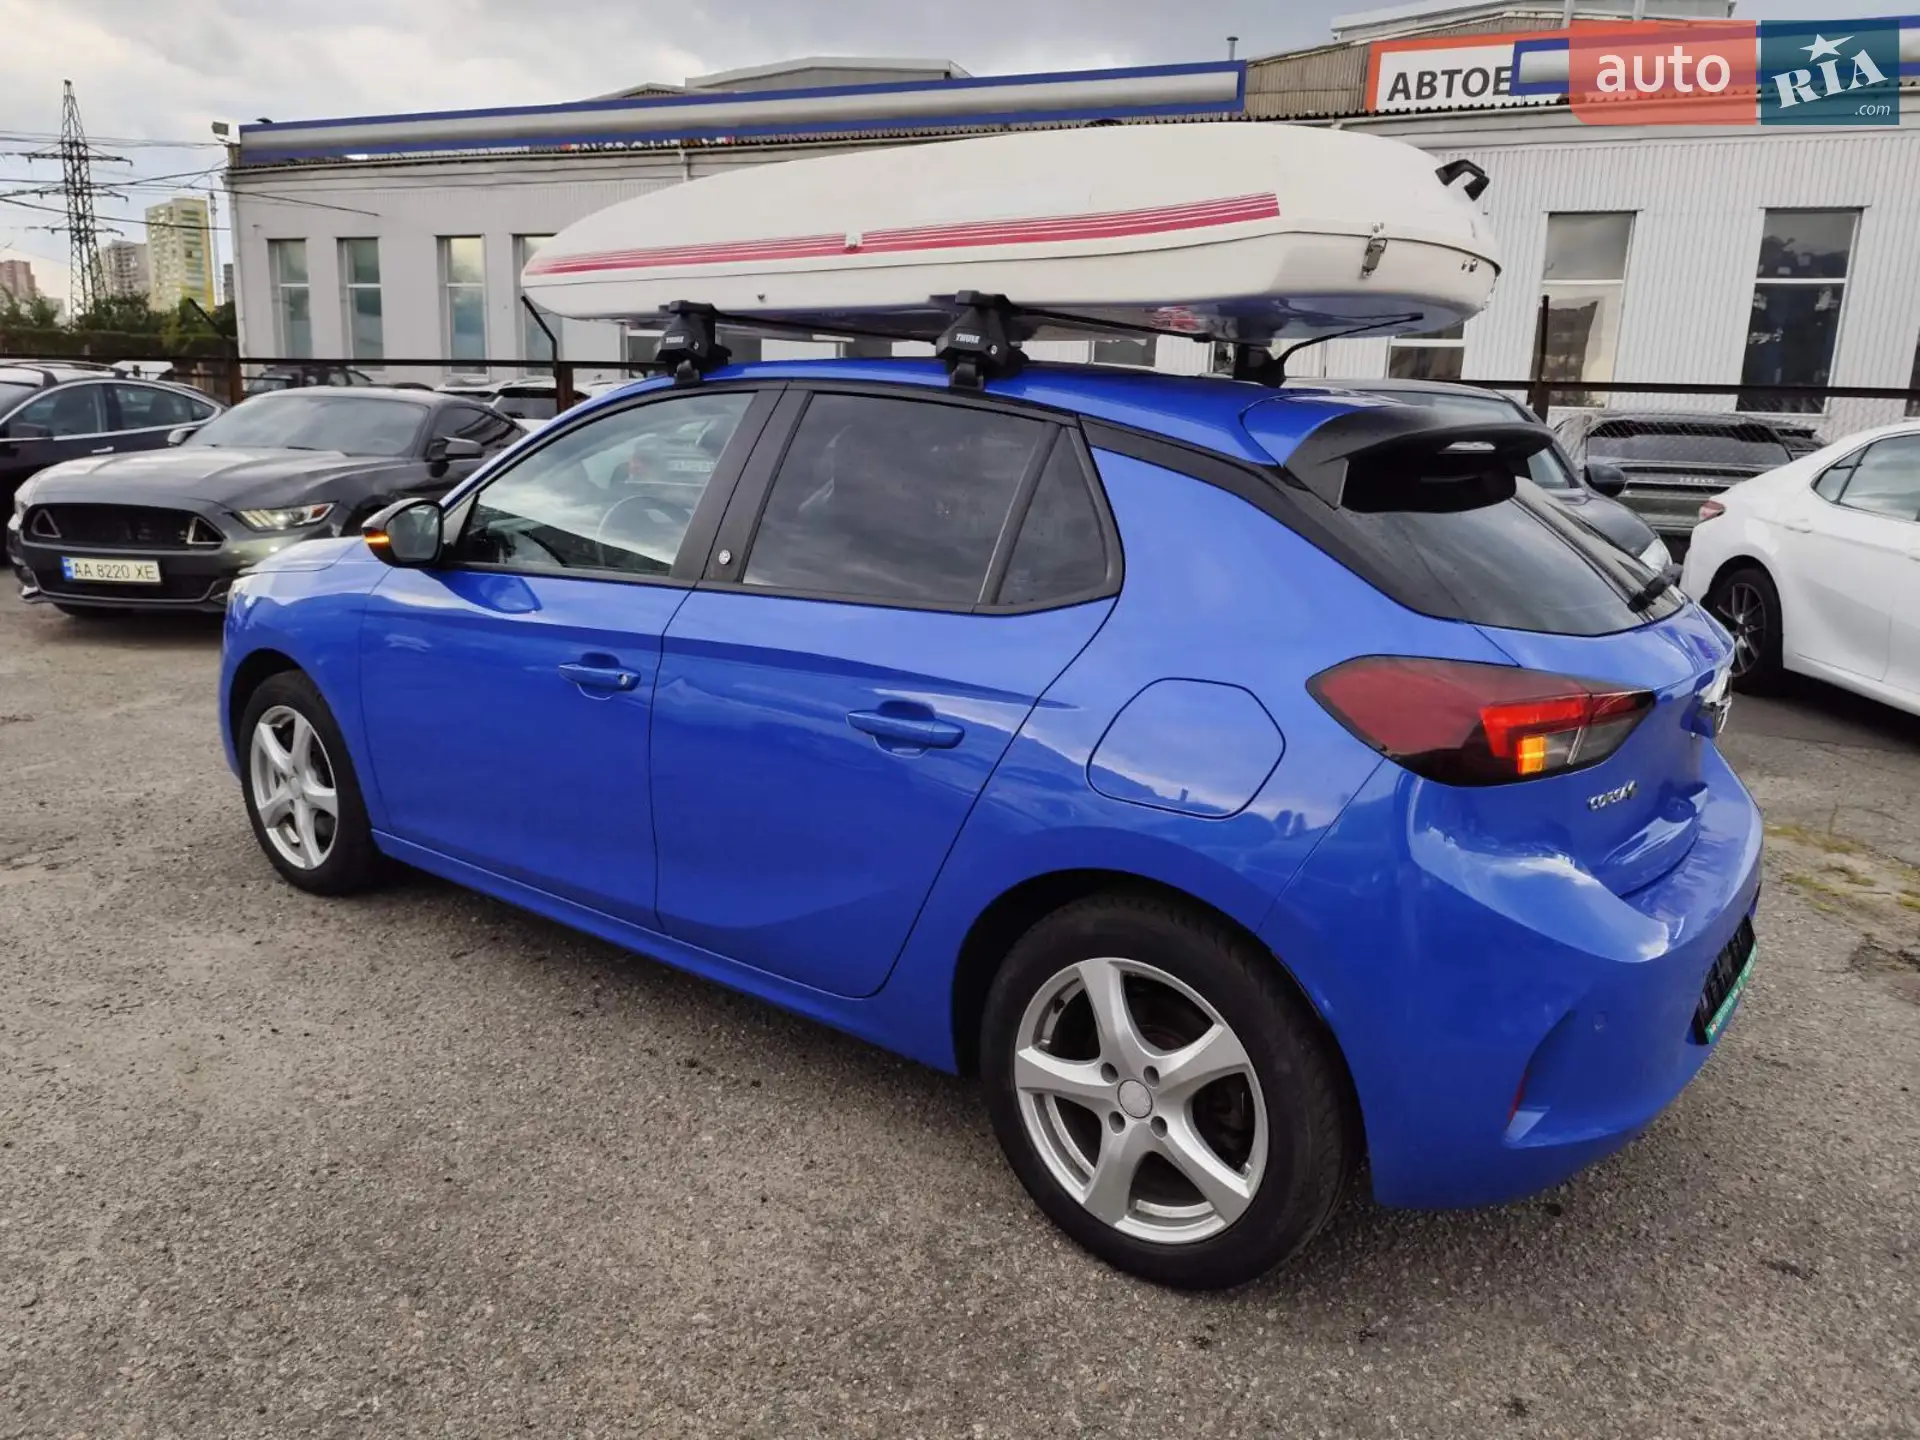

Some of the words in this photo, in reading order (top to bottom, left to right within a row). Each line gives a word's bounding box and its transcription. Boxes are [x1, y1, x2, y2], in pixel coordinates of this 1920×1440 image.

[74, 562, 93, 577] AA
[95, 564, 131, 579] 8220
[134, 564, 157, 580] XE
